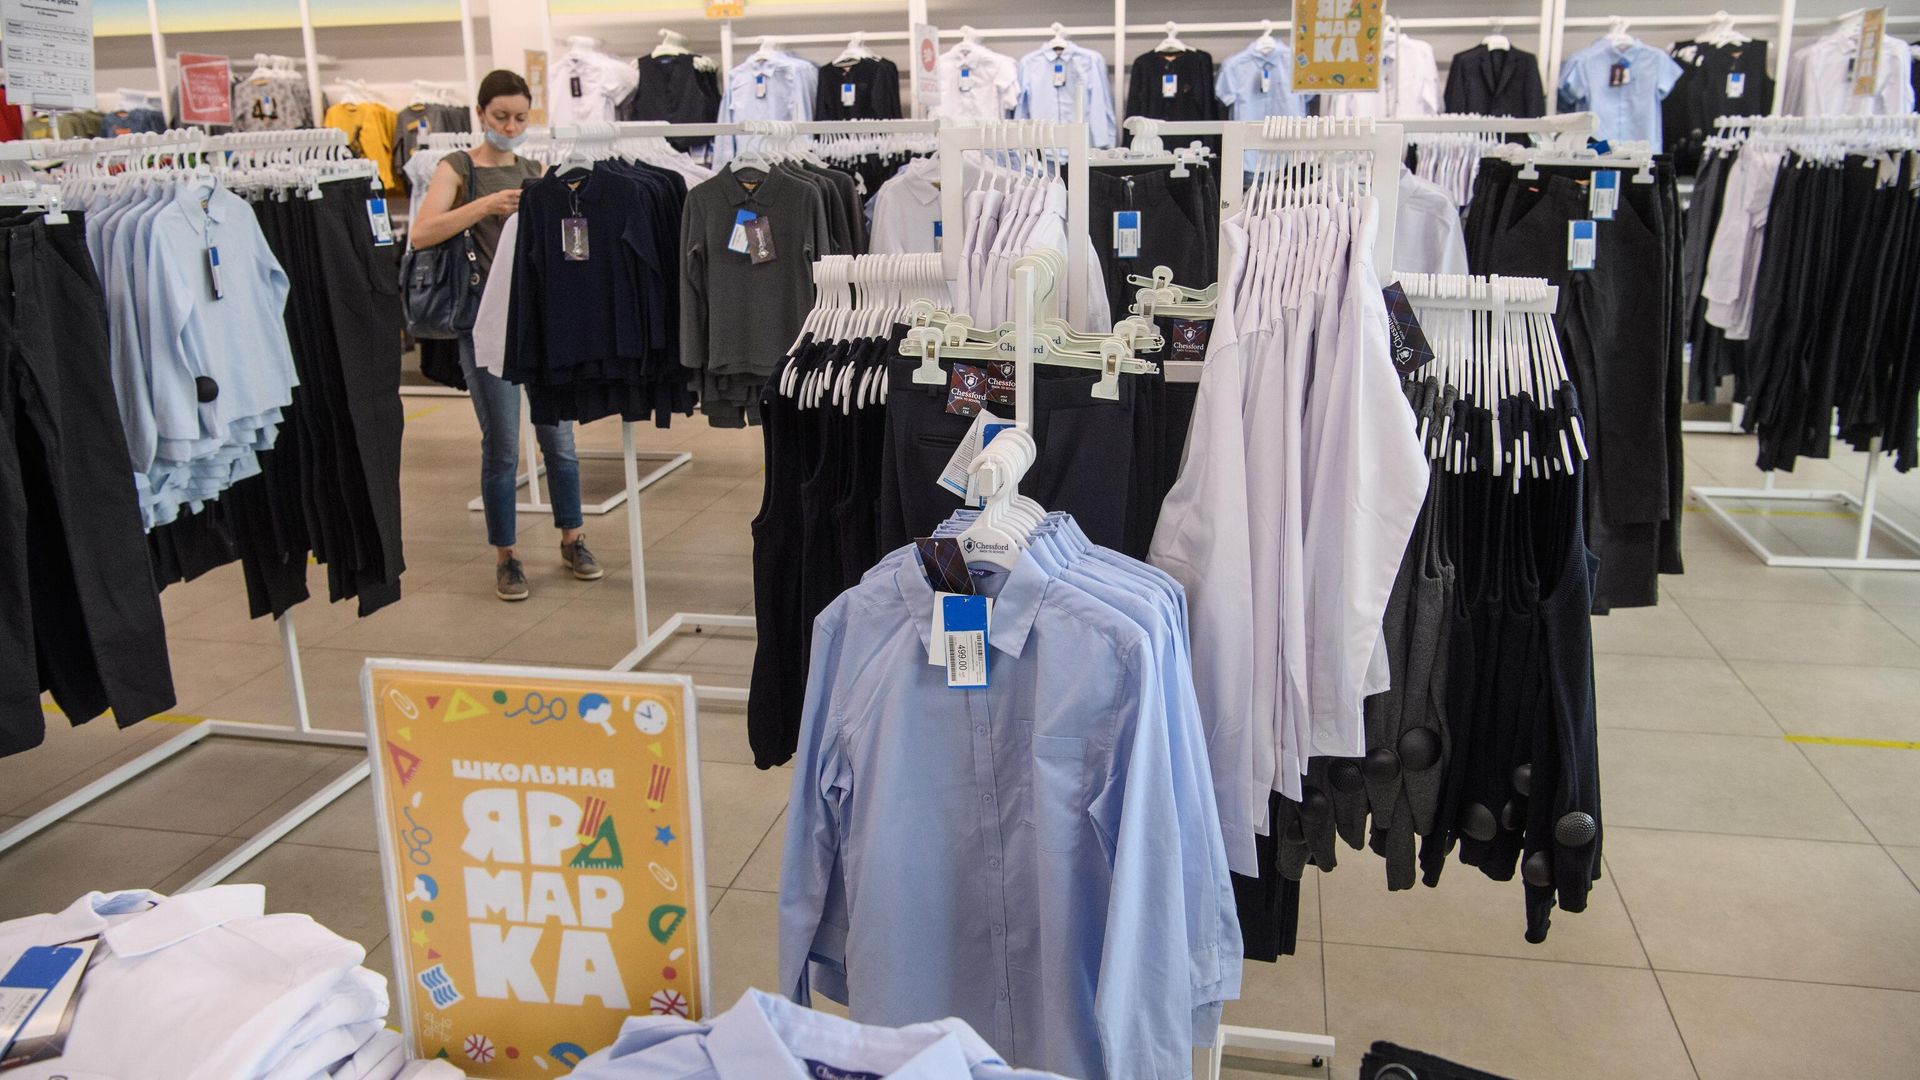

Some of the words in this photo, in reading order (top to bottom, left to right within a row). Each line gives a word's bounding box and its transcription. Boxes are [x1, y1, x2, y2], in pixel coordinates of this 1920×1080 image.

[1314, 20, 1361, 37] МАР
[1313, 37, 1360, 62] КА
[1173, 341, 1204, 351] Chessford
[951, 387, 987, 401] Chessford
[987, 377, 1016, 387] Chessfo
[975, 541, 1009, 551] Chessford
[957, 644, 968, 671] 499.00
[452, 758, 616, 789] ШКОЛЬНАЯ
[461, 788, 583, 867] ЯР
[463, 866, 625, 929] МАР
[469, 922, 631, 1010] КА
